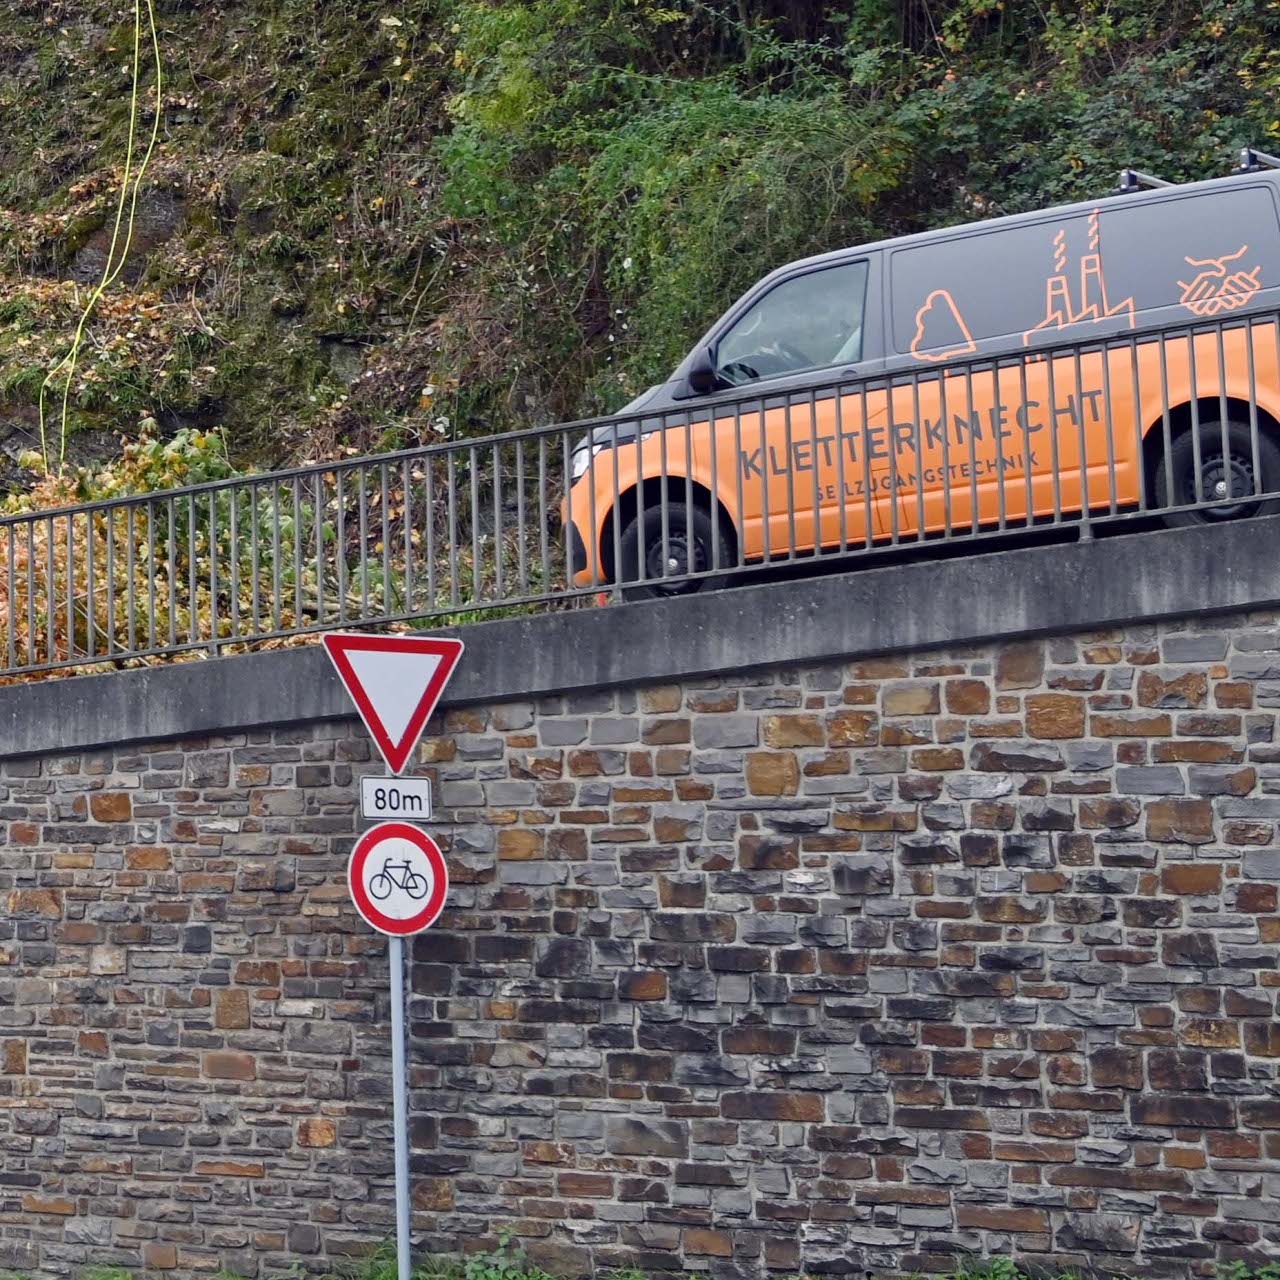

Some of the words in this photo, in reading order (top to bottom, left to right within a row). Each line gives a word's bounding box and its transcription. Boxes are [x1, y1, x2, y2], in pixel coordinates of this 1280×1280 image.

[740, 390, 1102, 480] KLETTERKNECHT
[816, 451, 1039, 502] SELZUGANGSTECHNIK
[374, 788, 422, 811] 80m
